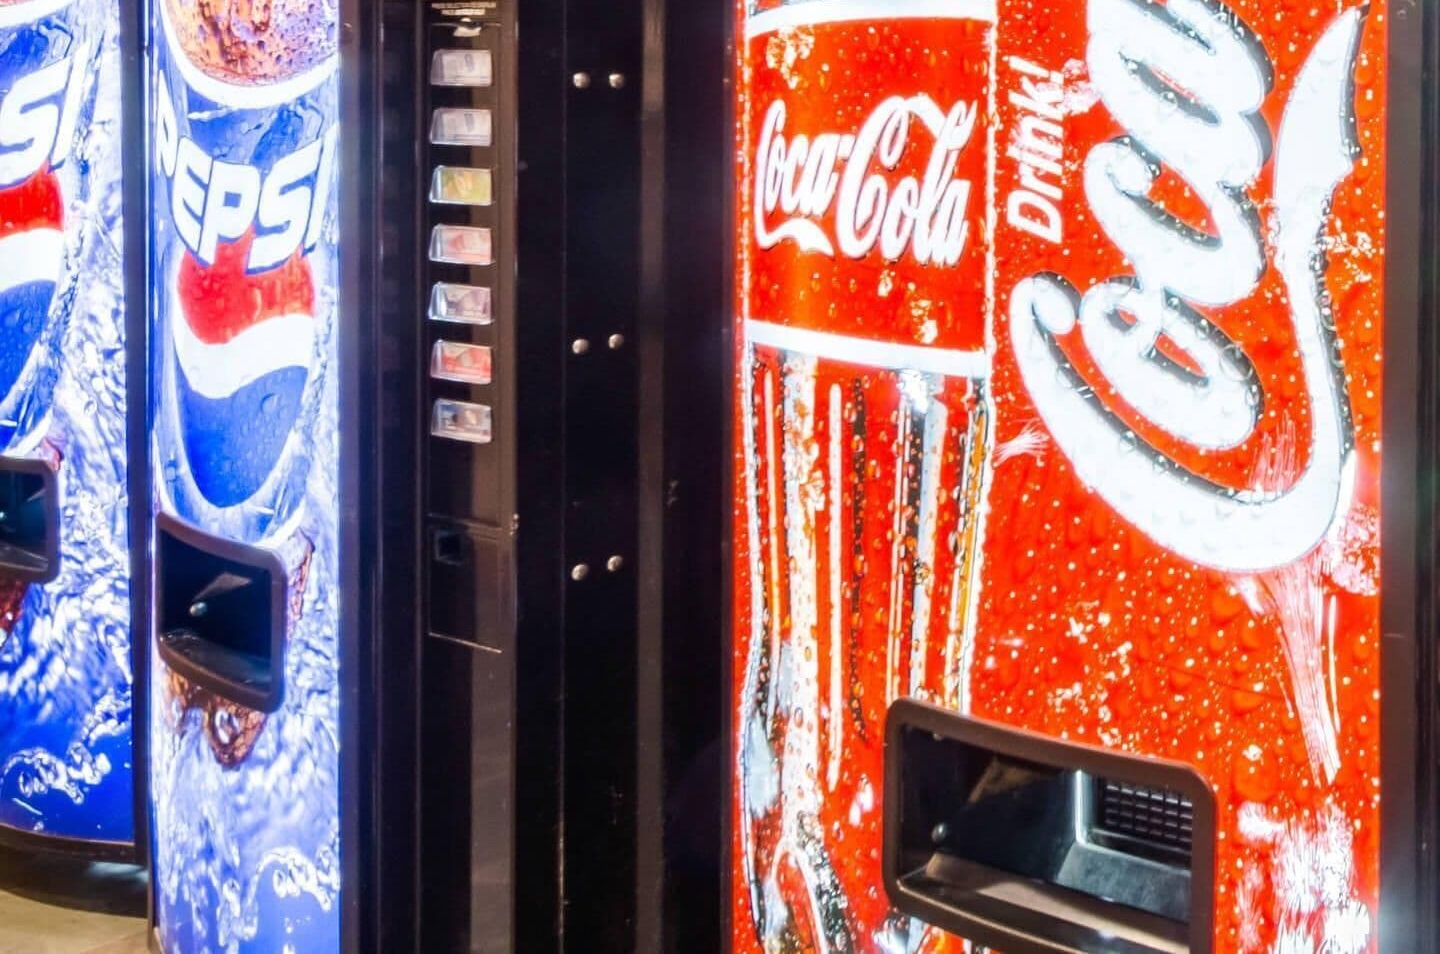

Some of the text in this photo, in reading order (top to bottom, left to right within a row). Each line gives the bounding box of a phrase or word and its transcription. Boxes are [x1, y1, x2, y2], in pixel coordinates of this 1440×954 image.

[156, 68, 338, 276] PEPSI
[754, 92, 979, 268] Coca-Cola
[1005, 55, 1064, 244] Drink!
